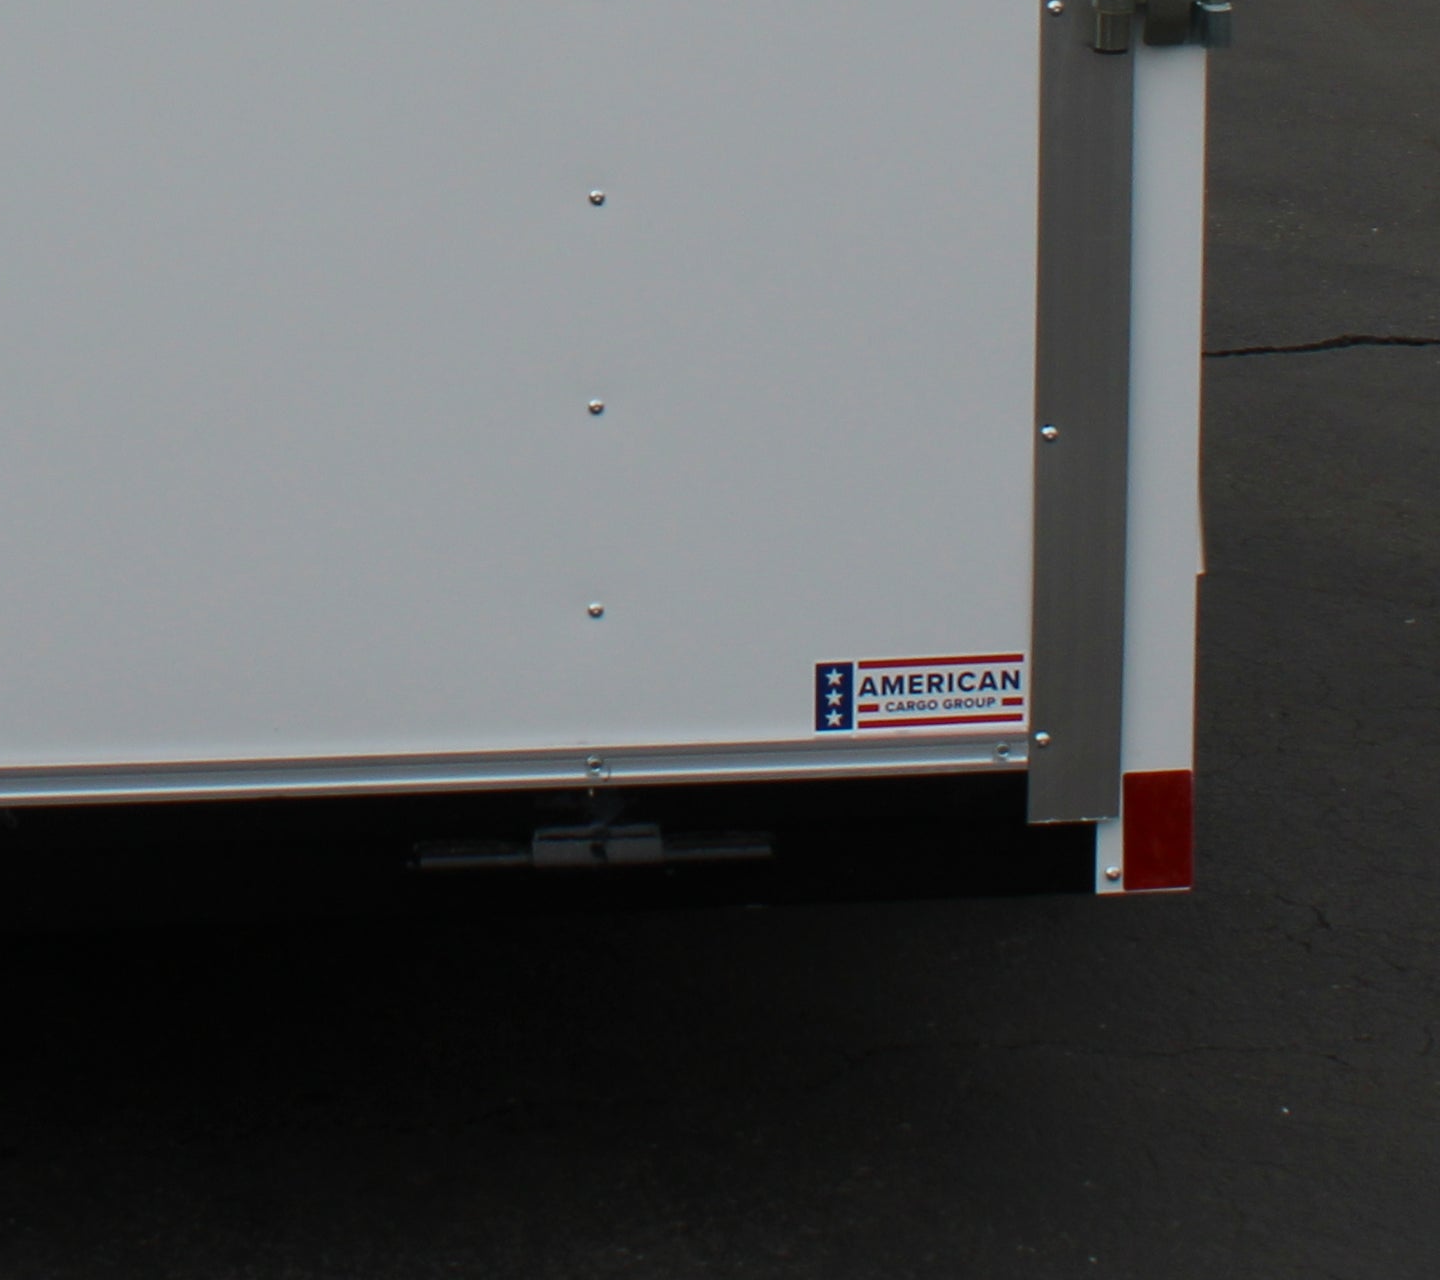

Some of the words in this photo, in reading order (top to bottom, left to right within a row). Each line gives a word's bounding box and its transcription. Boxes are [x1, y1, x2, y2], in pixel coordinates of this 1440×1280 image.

[859, 670, 1020, 697] AMERICAN
[885, 700, 938, 713] CARGO
[942, 696, 997, 710] GROUP
